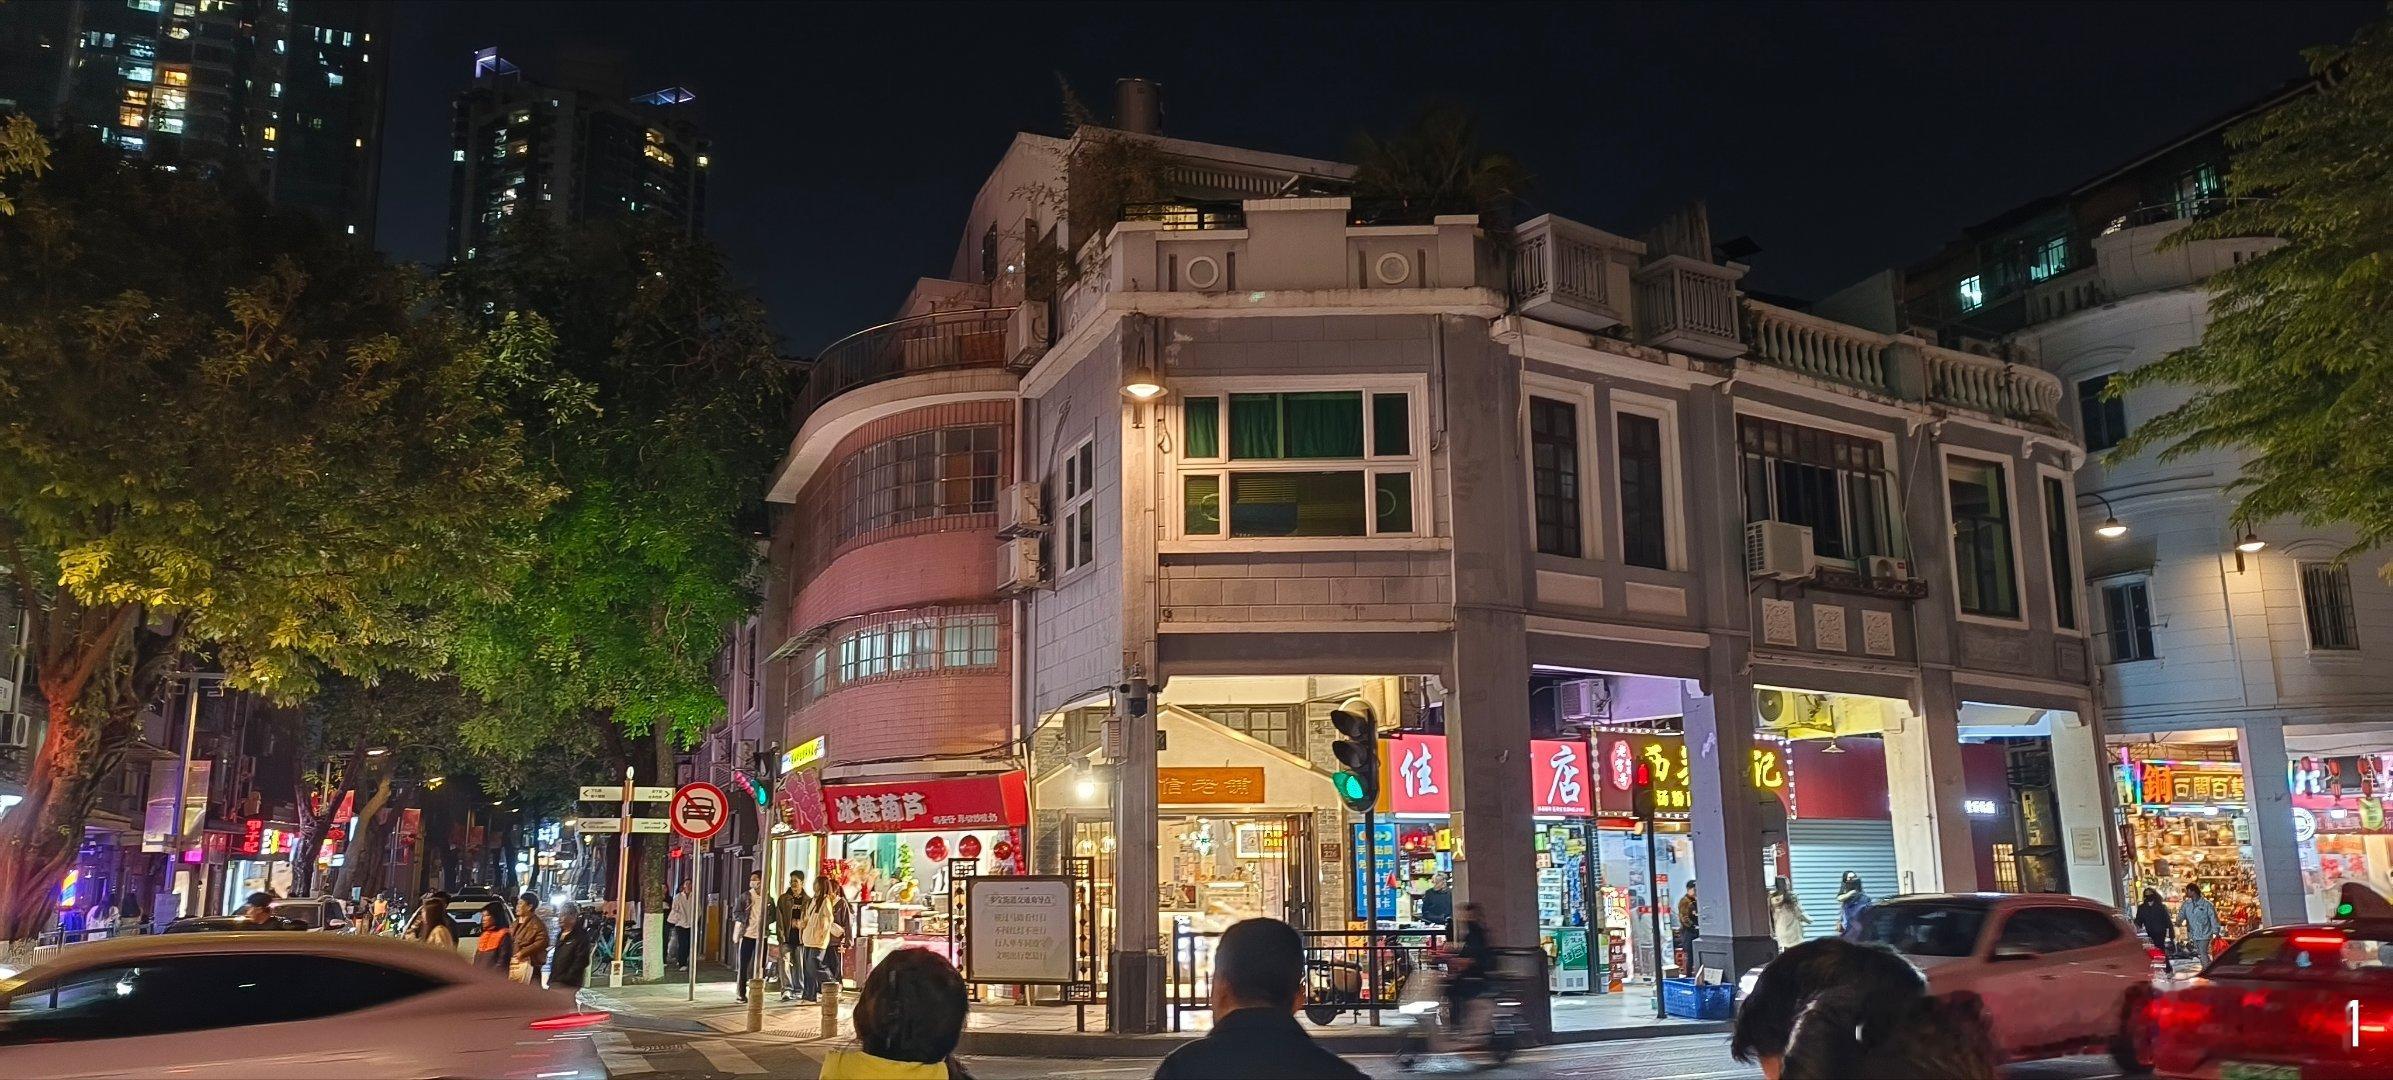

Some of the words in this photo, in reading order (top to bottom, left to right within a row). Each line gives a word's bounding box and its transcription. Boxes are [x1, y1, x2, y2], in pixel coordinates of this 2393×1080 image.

[1399, 741, 1439, 799] 佳
[1546, 744, 1581, 805] 店
[1753, 749, 1783, 788] 记
[835, 791, 927, 824] 冰糖葫芦
